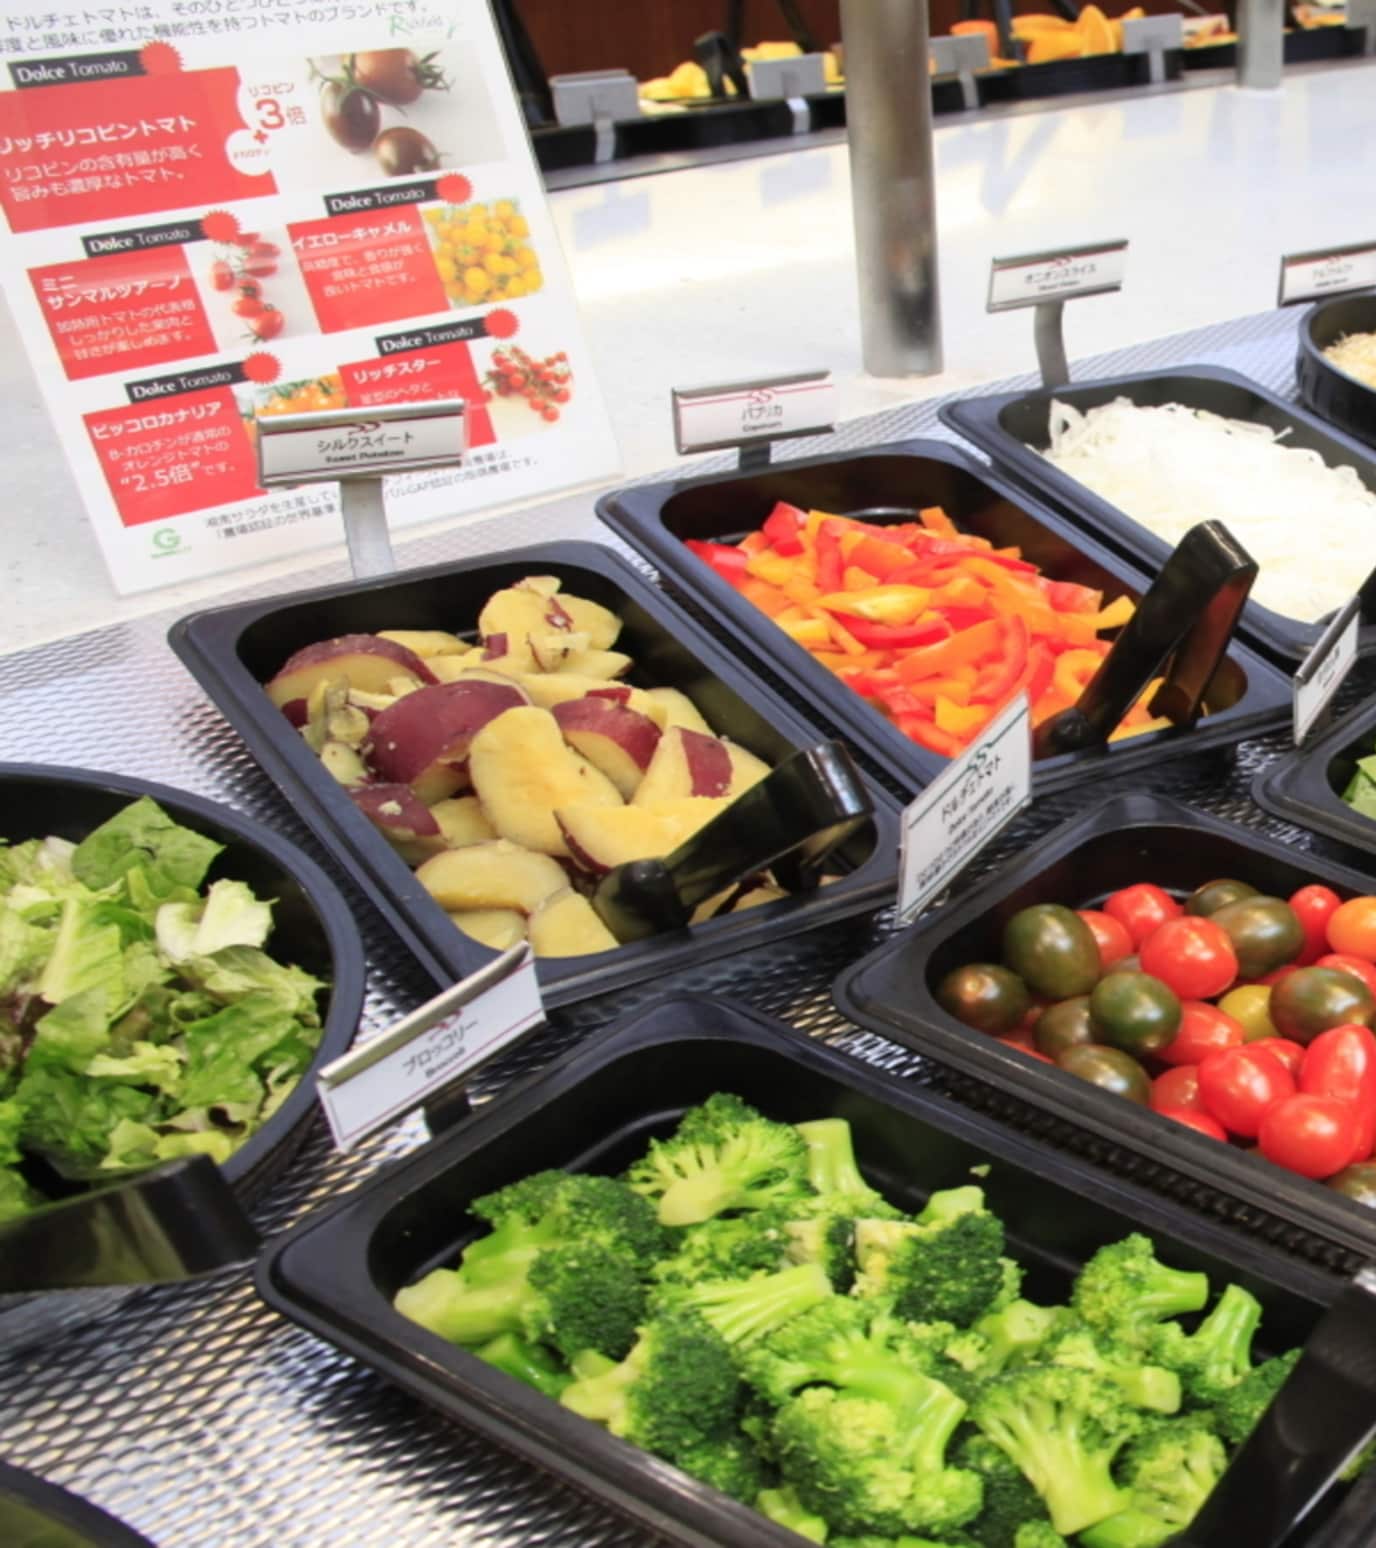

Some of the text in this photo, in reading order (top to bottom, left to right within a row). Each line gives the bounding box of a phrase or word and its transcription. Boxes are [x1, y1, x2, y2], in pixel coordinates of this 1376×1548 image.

[17, 59, 129, 83] Dolce Tomato
[331, 187, 426, 212] Dolce Tomato
[89, 228, 191, 252] Dolce Tomato
[381, 326, 474, 353] Dolce Tomato
[353, 357, 442, 384] リッチスター
[132, 370, 233, 399] Dolce Tomato
[317, 431, 414, 454] シルクスイート
